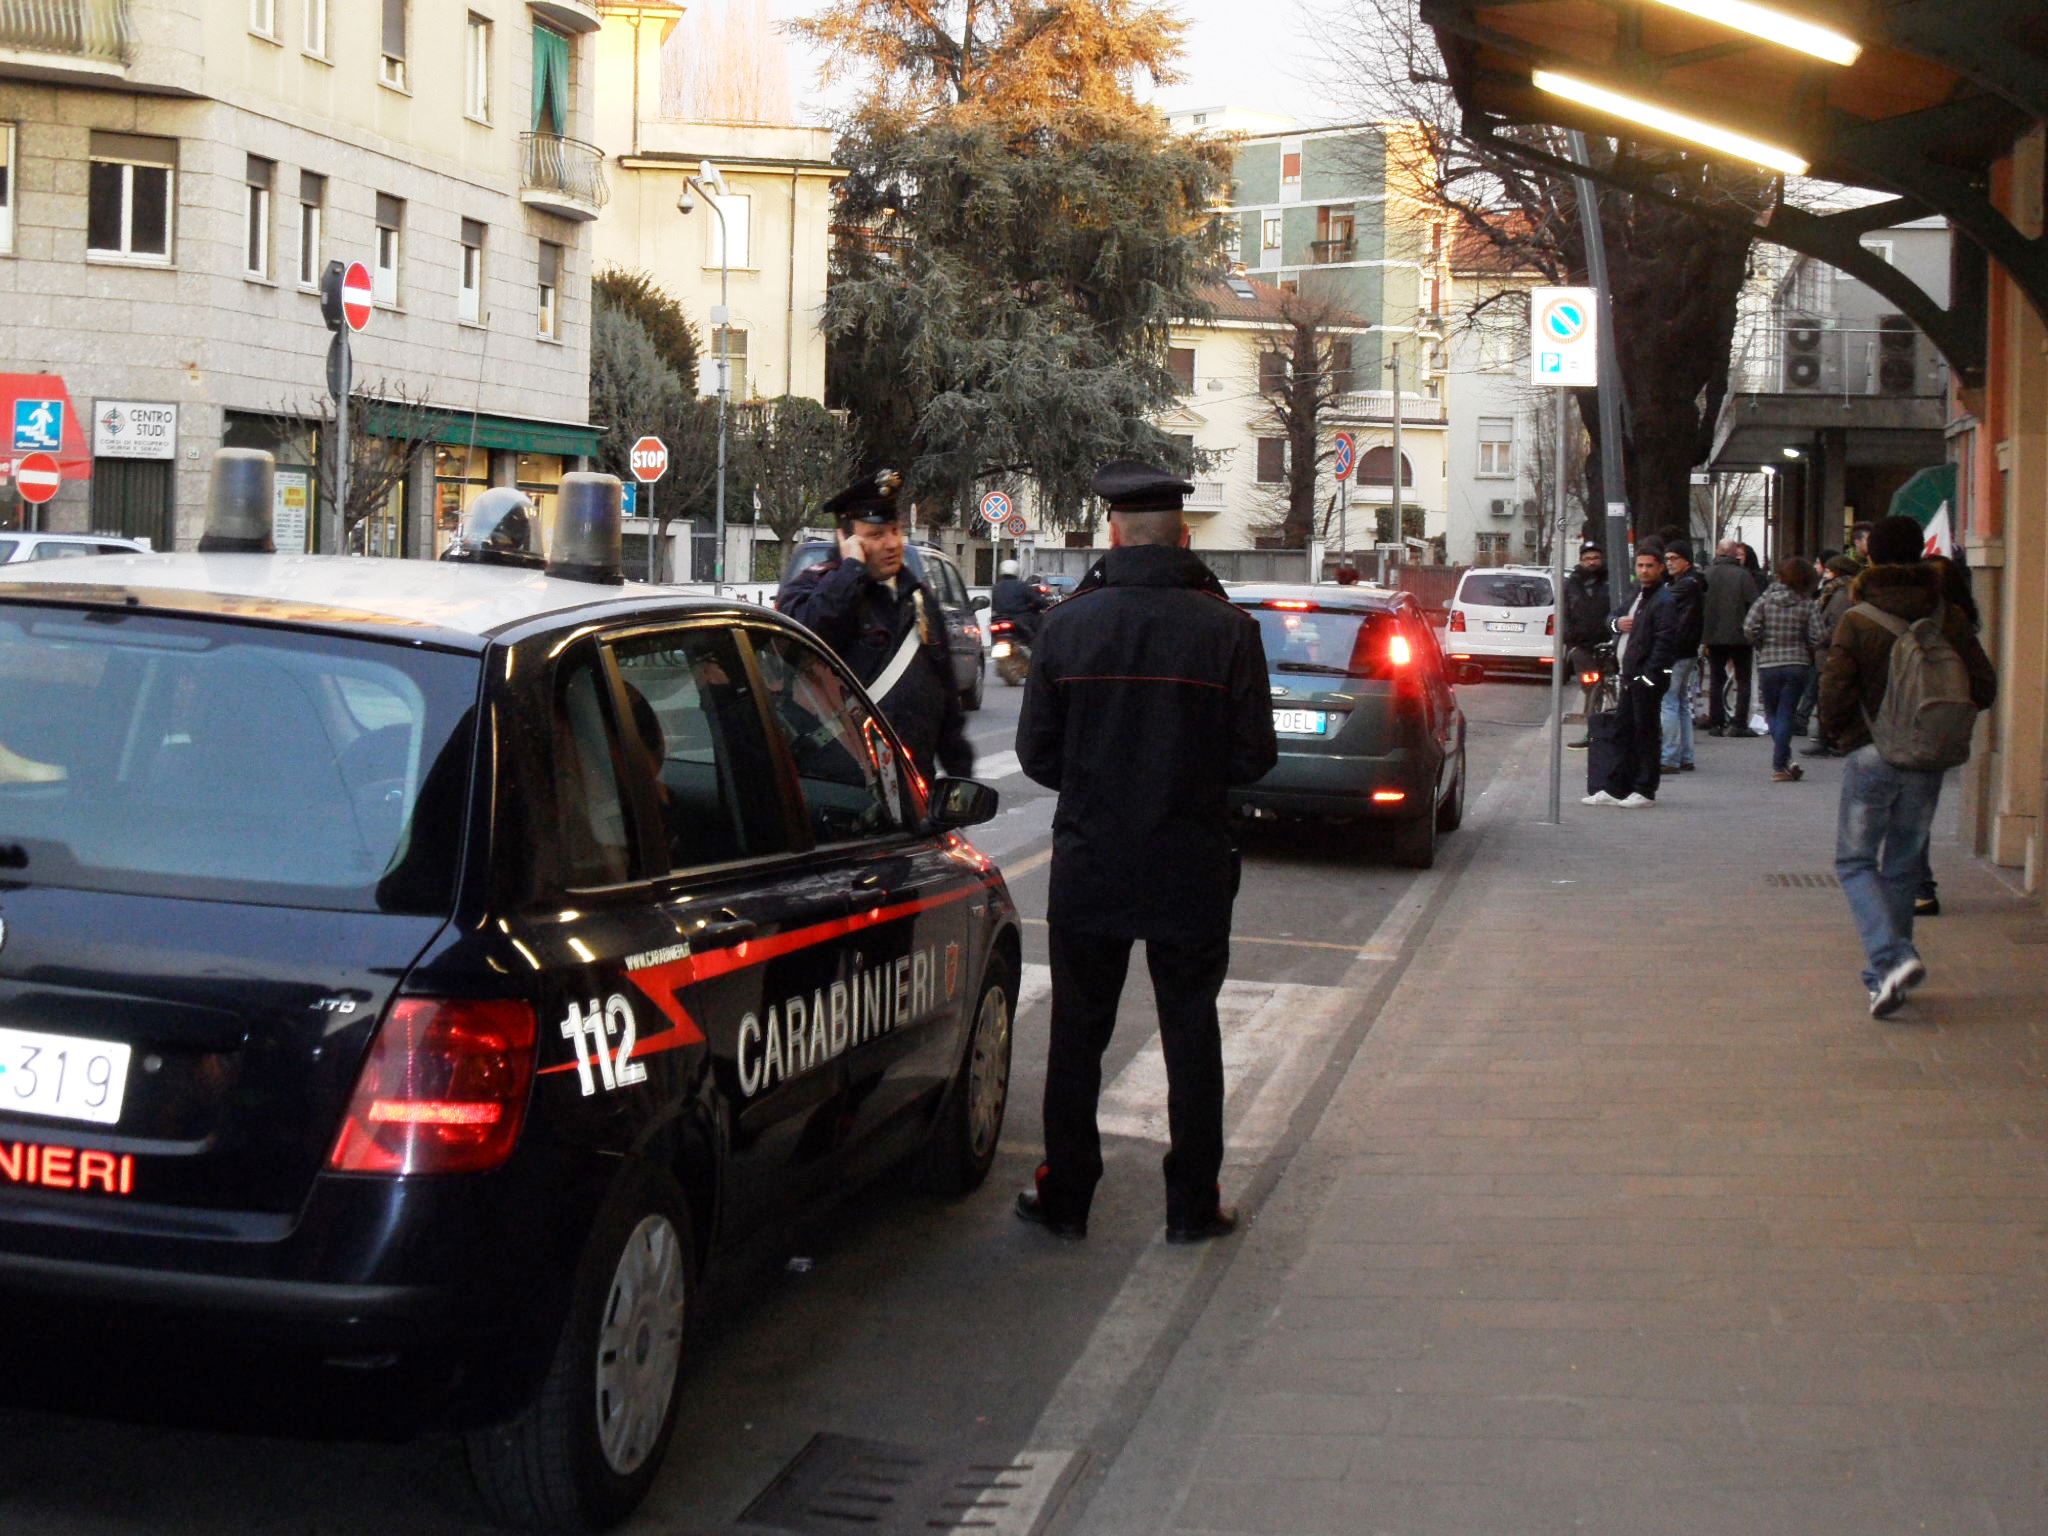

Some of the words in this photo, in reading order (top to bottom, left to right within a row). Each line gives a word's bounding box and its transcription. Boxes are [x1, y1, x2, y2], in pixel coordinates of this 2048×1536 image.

[130, 409, 173, 424] CENTRO
[136, 424, 166, 437] STUDI
[633, 451, 665, 468] STOP
[738, 945, 936, 1098] CARABINIERI
[560, 993, 648, 1097] 112
[14, 1044, 113, 1108] 319
